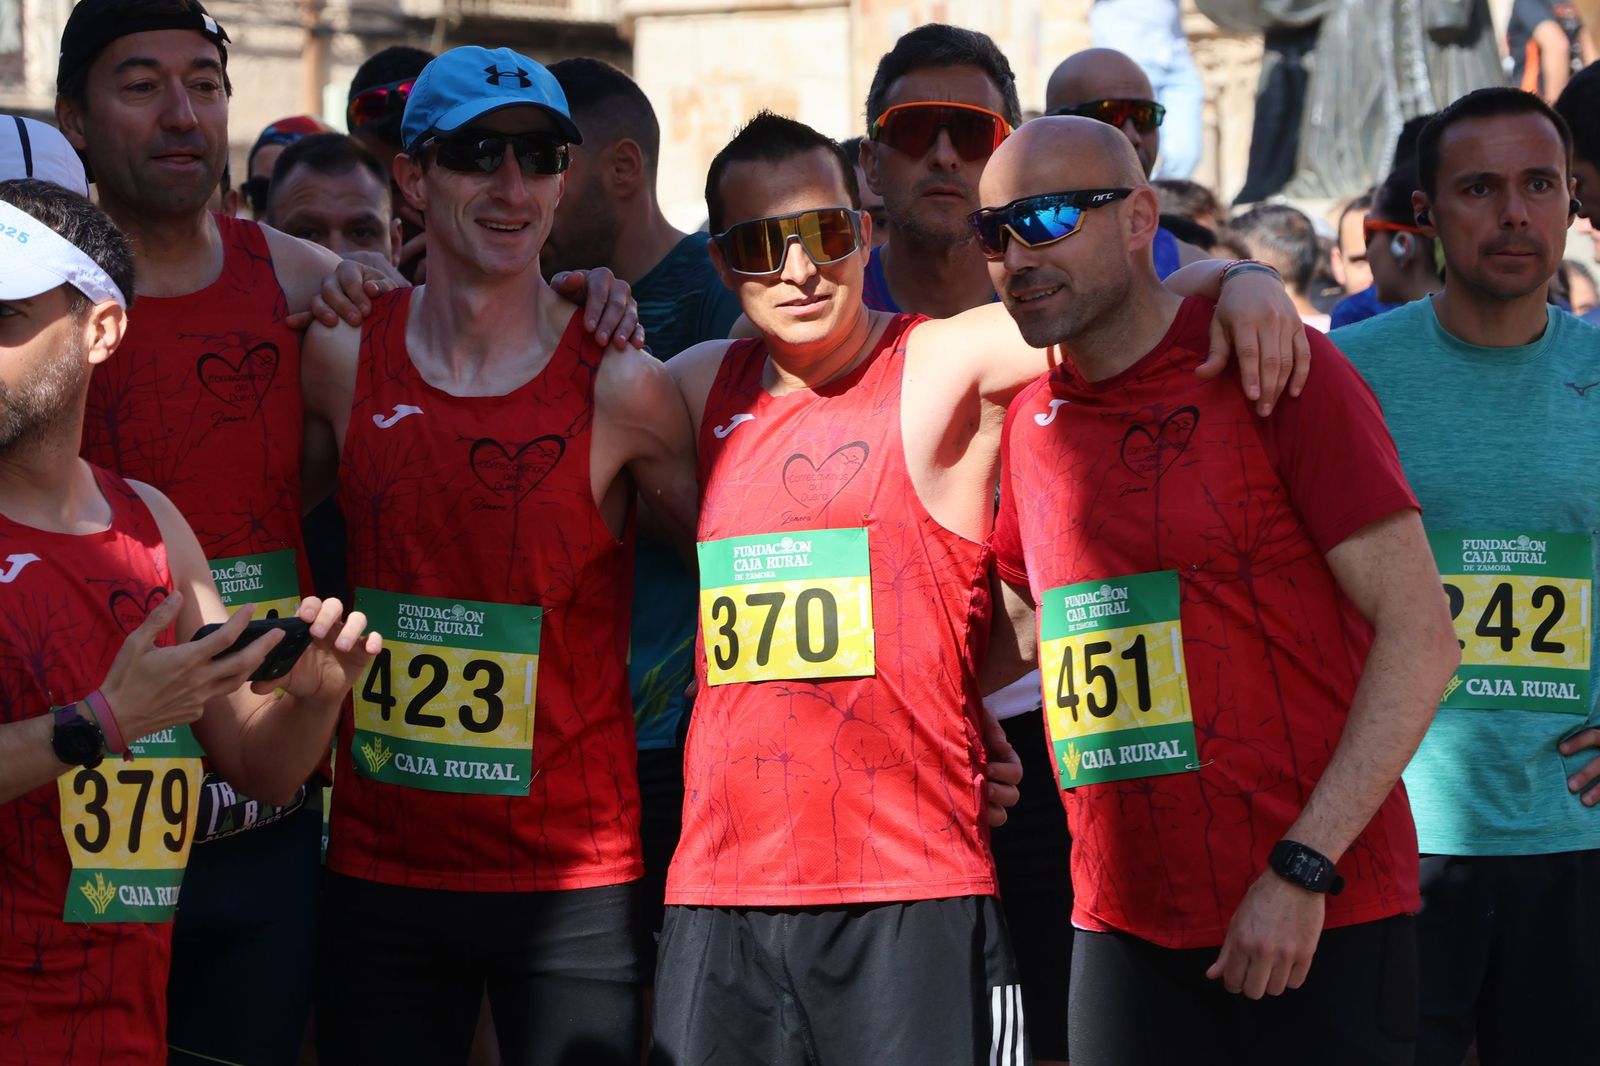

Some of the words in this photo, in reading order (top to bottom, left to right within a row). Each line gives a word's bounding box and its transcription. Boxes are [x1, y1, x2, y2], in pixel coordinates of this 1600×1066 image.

[733, 557, 763, 572] CAJA
[766, 553, 813, 569] RURAL
[1462, 551, 1497, 564] CAJA
[1501, 552, 1547, 565] RURAL
[1463, 564, 1475, 572] DE
[1477, 564, 1512, 572] ZAMORA
[221, 577, 264, 594] RURAL
[745, 571, 777, 581] ZAMORA
[1066, 606, 1087, 623] CAJA
[1089, 601, 1130, 619] RURAL
[397, 616, 431, 632] CAJA
[433, 620, 484, 637] RURAL
[397, 630, 408, 639] DE
[409, 632, 444, 643] ZAMORA
[711, 587, 839, 671] 370
[1056, 634, 1152, 722] 451
[1465, 678, 1517, 697] CAJA
[1521, 680, 1581, 700] RURAL
[362, 647, 505, 734] 423
[1081, 749, 1117, 769] CAJA
[1118, 739, 1188, 766] RURAL
[394, 752, 439, 776] CAJA
[443, 759, 520, 782] RURAL
[73, 768, 189, 854] 379
[118, 885, 154, 907] CAJA
